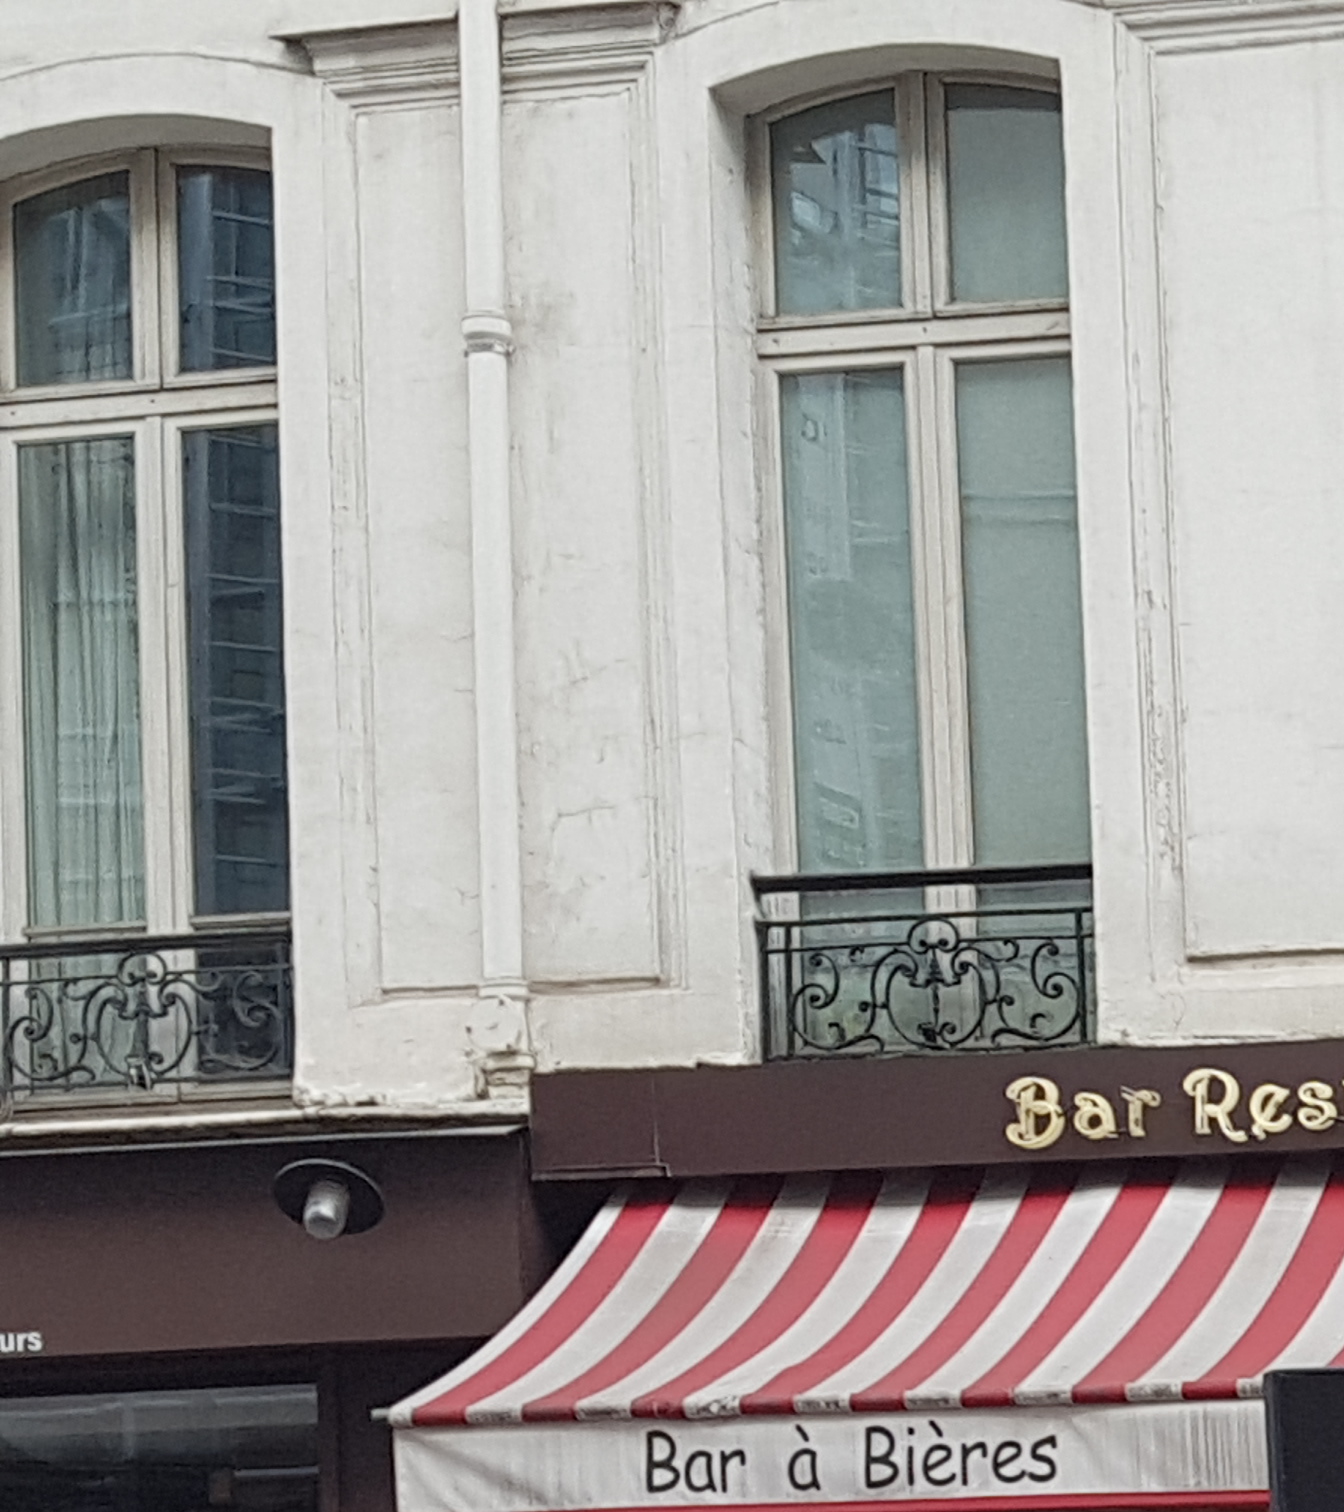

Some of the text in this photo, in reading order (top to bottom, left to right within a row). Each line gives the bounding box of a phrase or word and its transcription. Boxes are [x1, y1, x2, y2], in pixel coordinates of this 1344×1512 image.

[1003, 1076, 1161, 1150] Bar
[645, 1420, 1058, 1493] Bar à Bières
